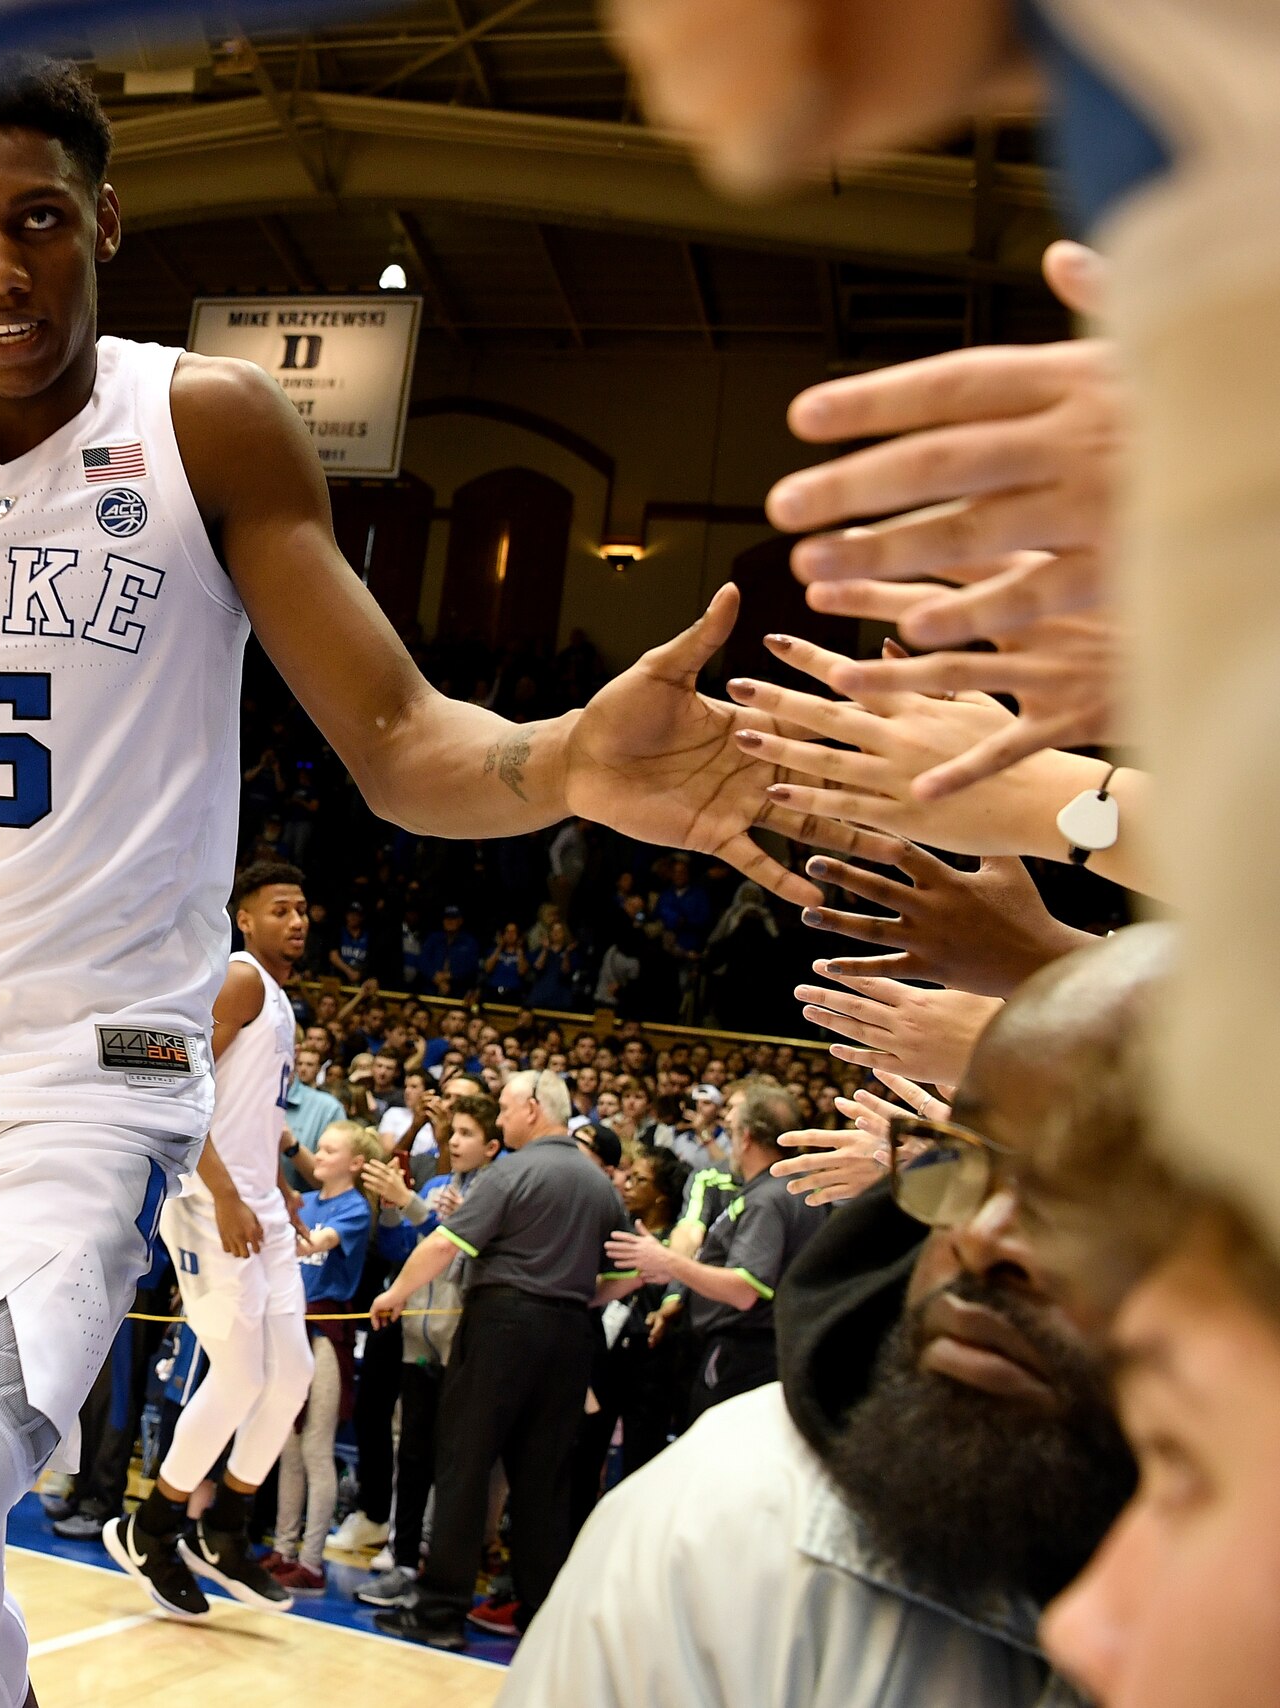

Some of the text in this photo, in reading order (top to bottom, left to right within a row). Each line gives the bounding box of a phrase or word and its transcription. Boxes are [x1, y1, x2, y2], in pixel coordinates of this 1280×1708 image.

[228, 311, 387, 328] MIKE KRZYZEWSKI
[279, 334, 323, 370] D
[103, 503, 143, 516] ACC
[106, 1032, 186, 1055] 44 NIKE
